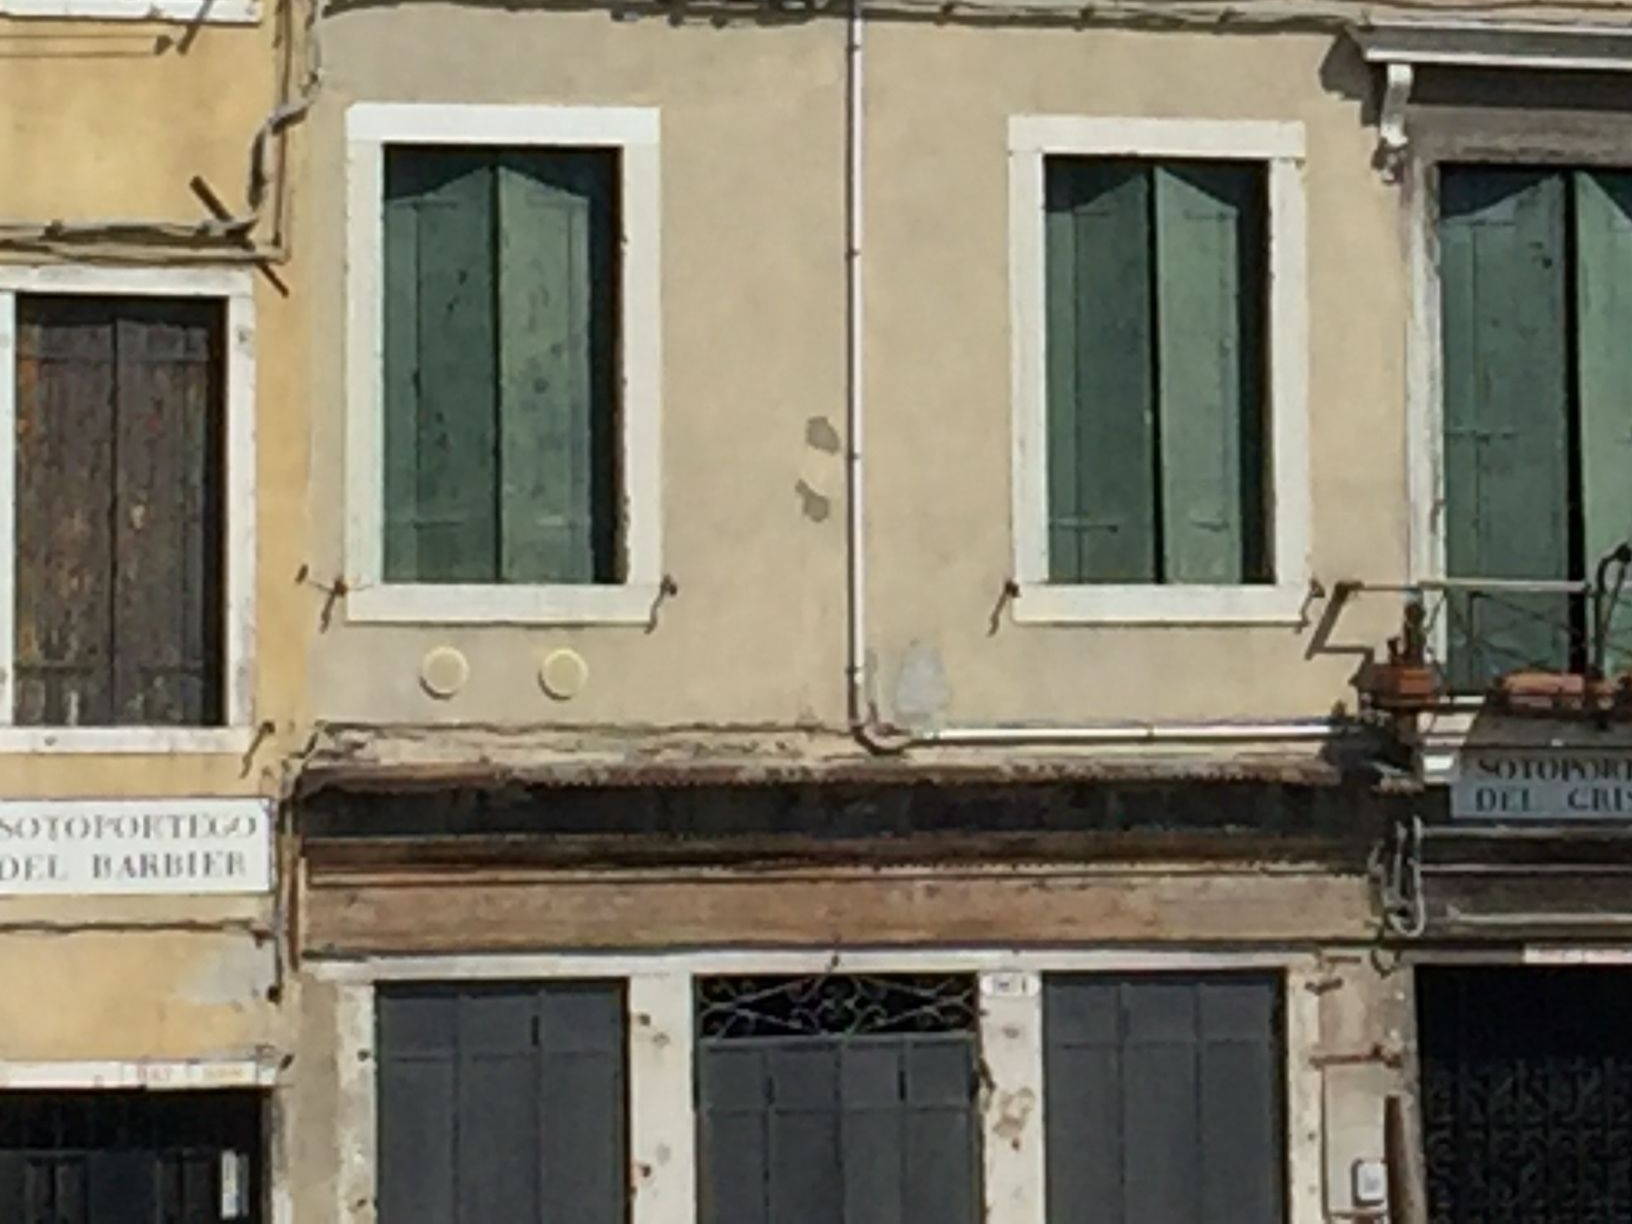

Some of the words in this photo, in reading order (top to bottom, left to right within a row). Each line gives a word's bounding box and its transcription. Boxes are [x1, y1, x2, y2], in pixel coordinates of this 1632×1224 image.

[1475, 787, 1534, 812] DEL
[0, 813, 258, 840] SOTOPORTEGO
[0, 853, 68, 881] DEL
[92, 851, 246, 879] BARBIER
